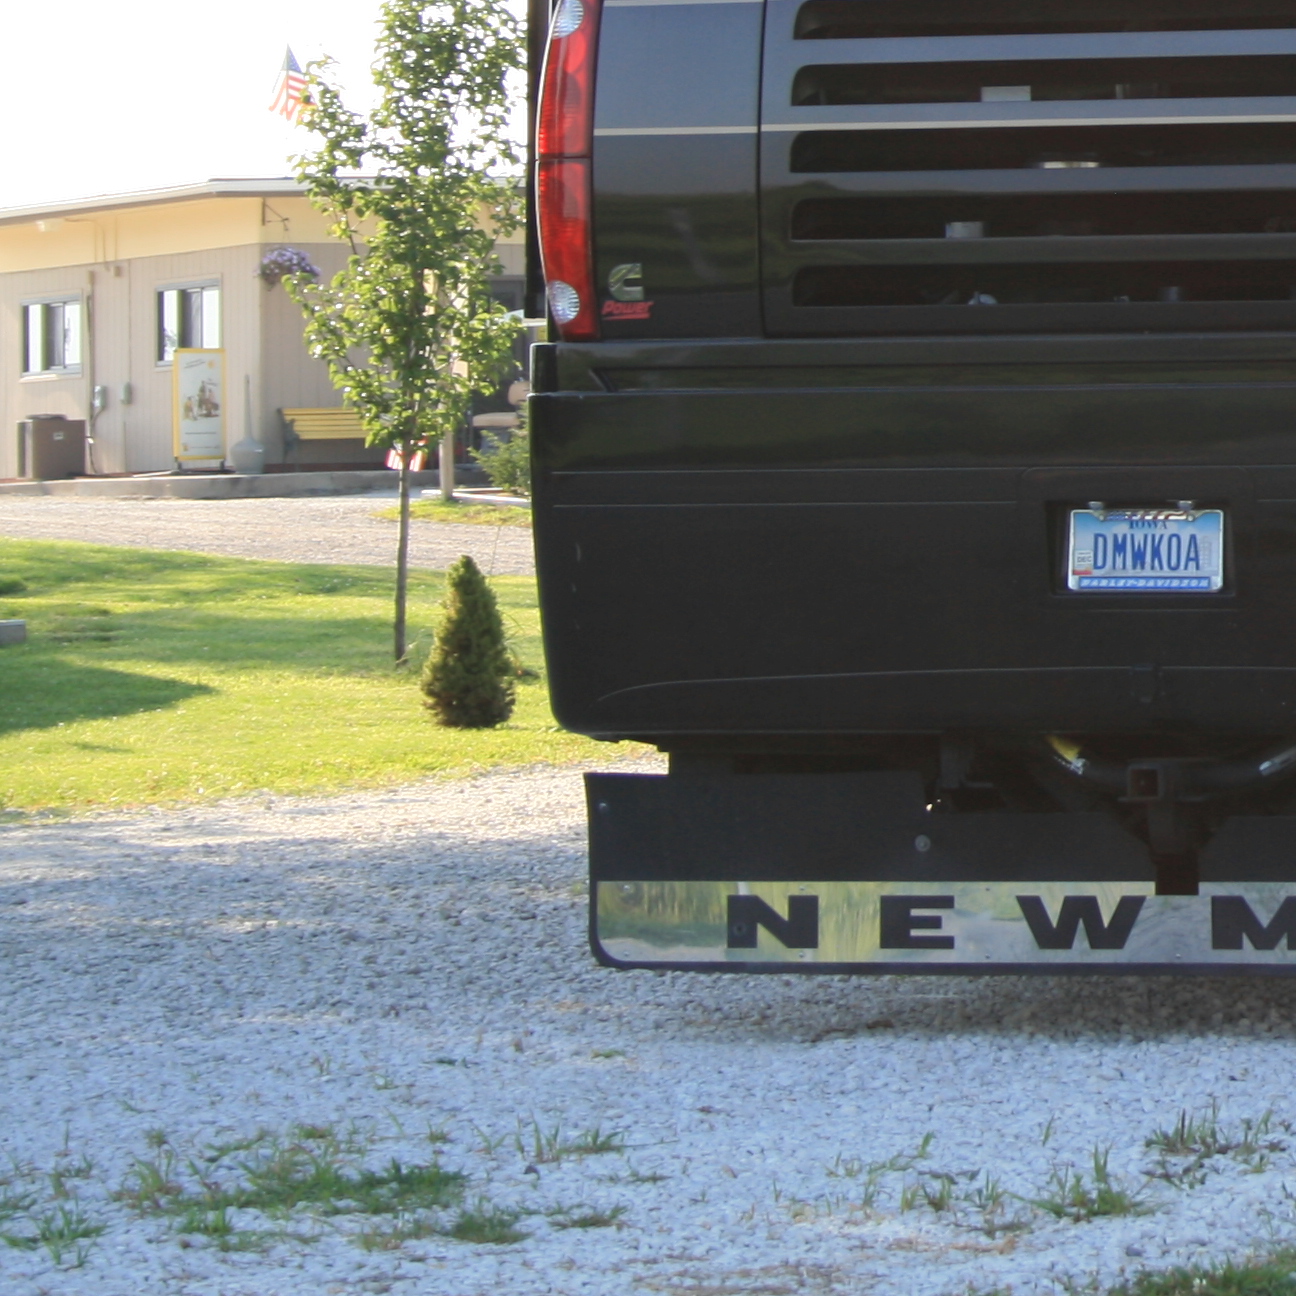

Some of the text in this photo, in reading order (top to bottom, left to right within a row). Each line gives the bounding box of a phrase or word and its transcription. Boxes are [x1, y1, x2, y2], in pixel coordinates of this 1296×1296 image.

[602, 301, 654, 315] Power
[1094, 533, 1200, 570] DMWKOA
[1081, 578, 1209, 587] HARLEY-DAVIDSON
